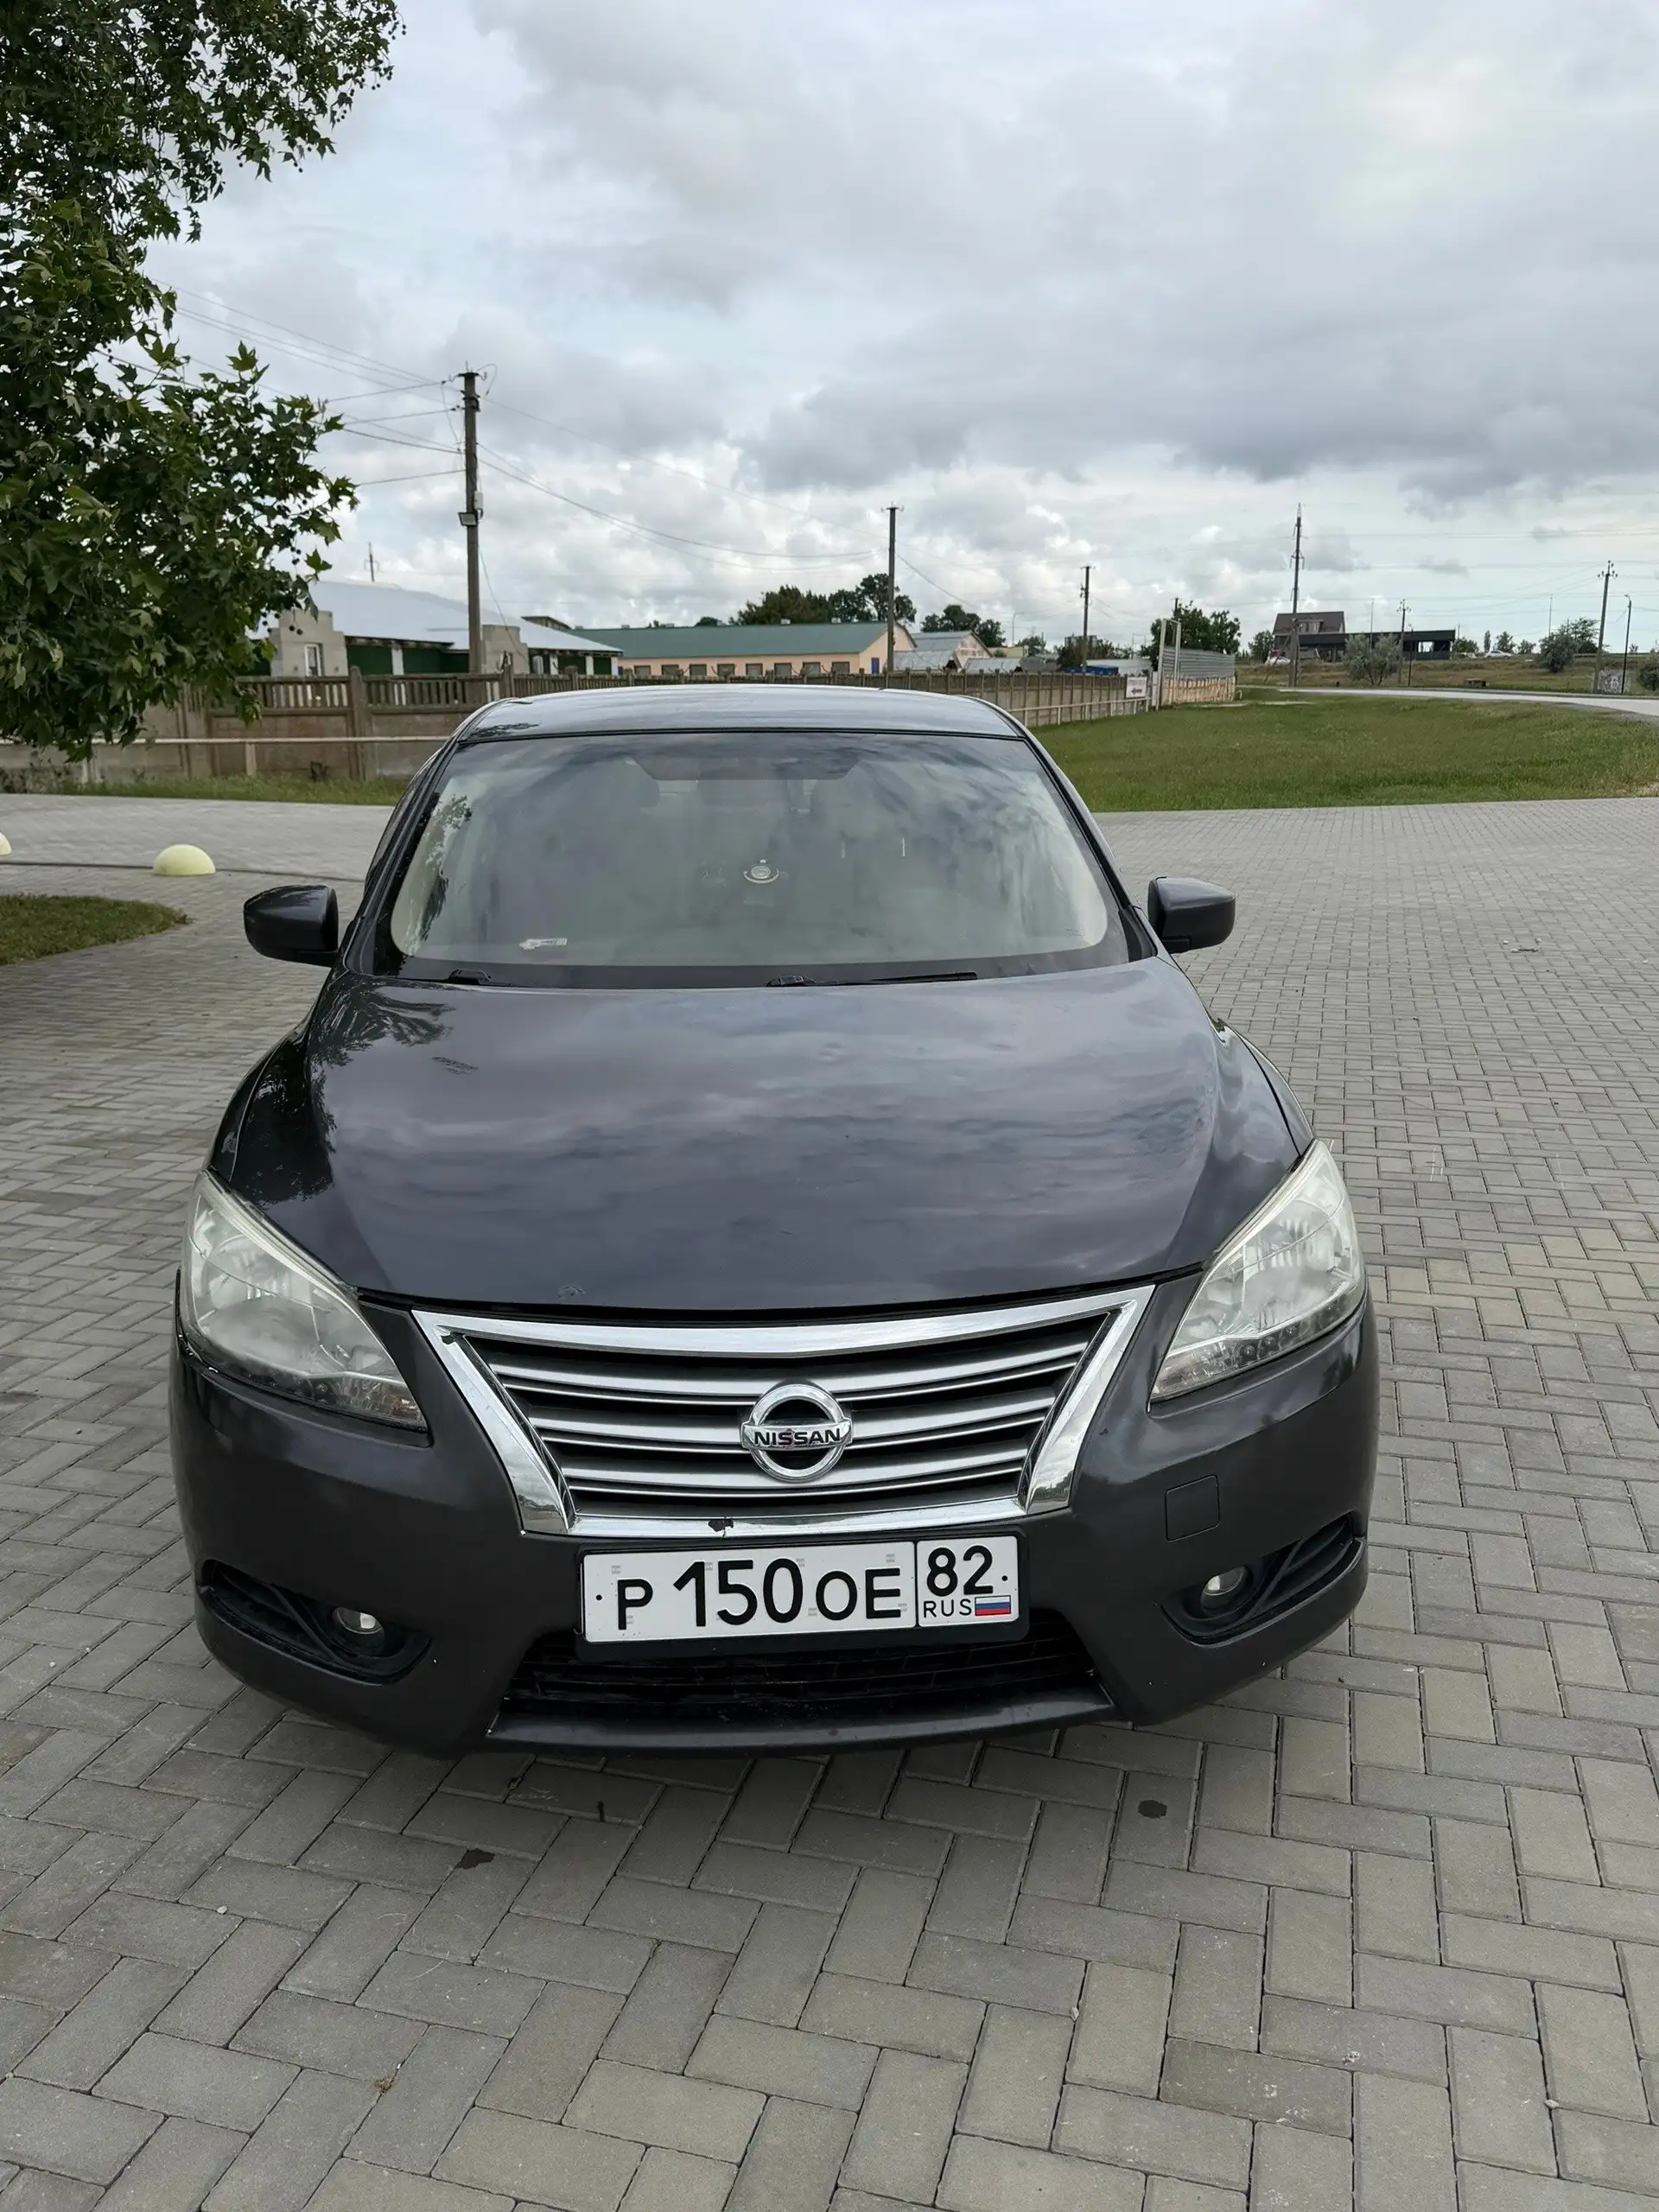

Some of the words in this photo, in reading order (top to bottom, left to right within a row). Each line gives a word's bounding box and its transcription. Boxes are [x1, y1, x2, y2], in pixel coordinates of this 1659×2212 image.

[754, 1427, 841, 1446] NISSAN
[926, 1545, 994, 1598] 82
[923, 1598, 972, 1618] RUS
